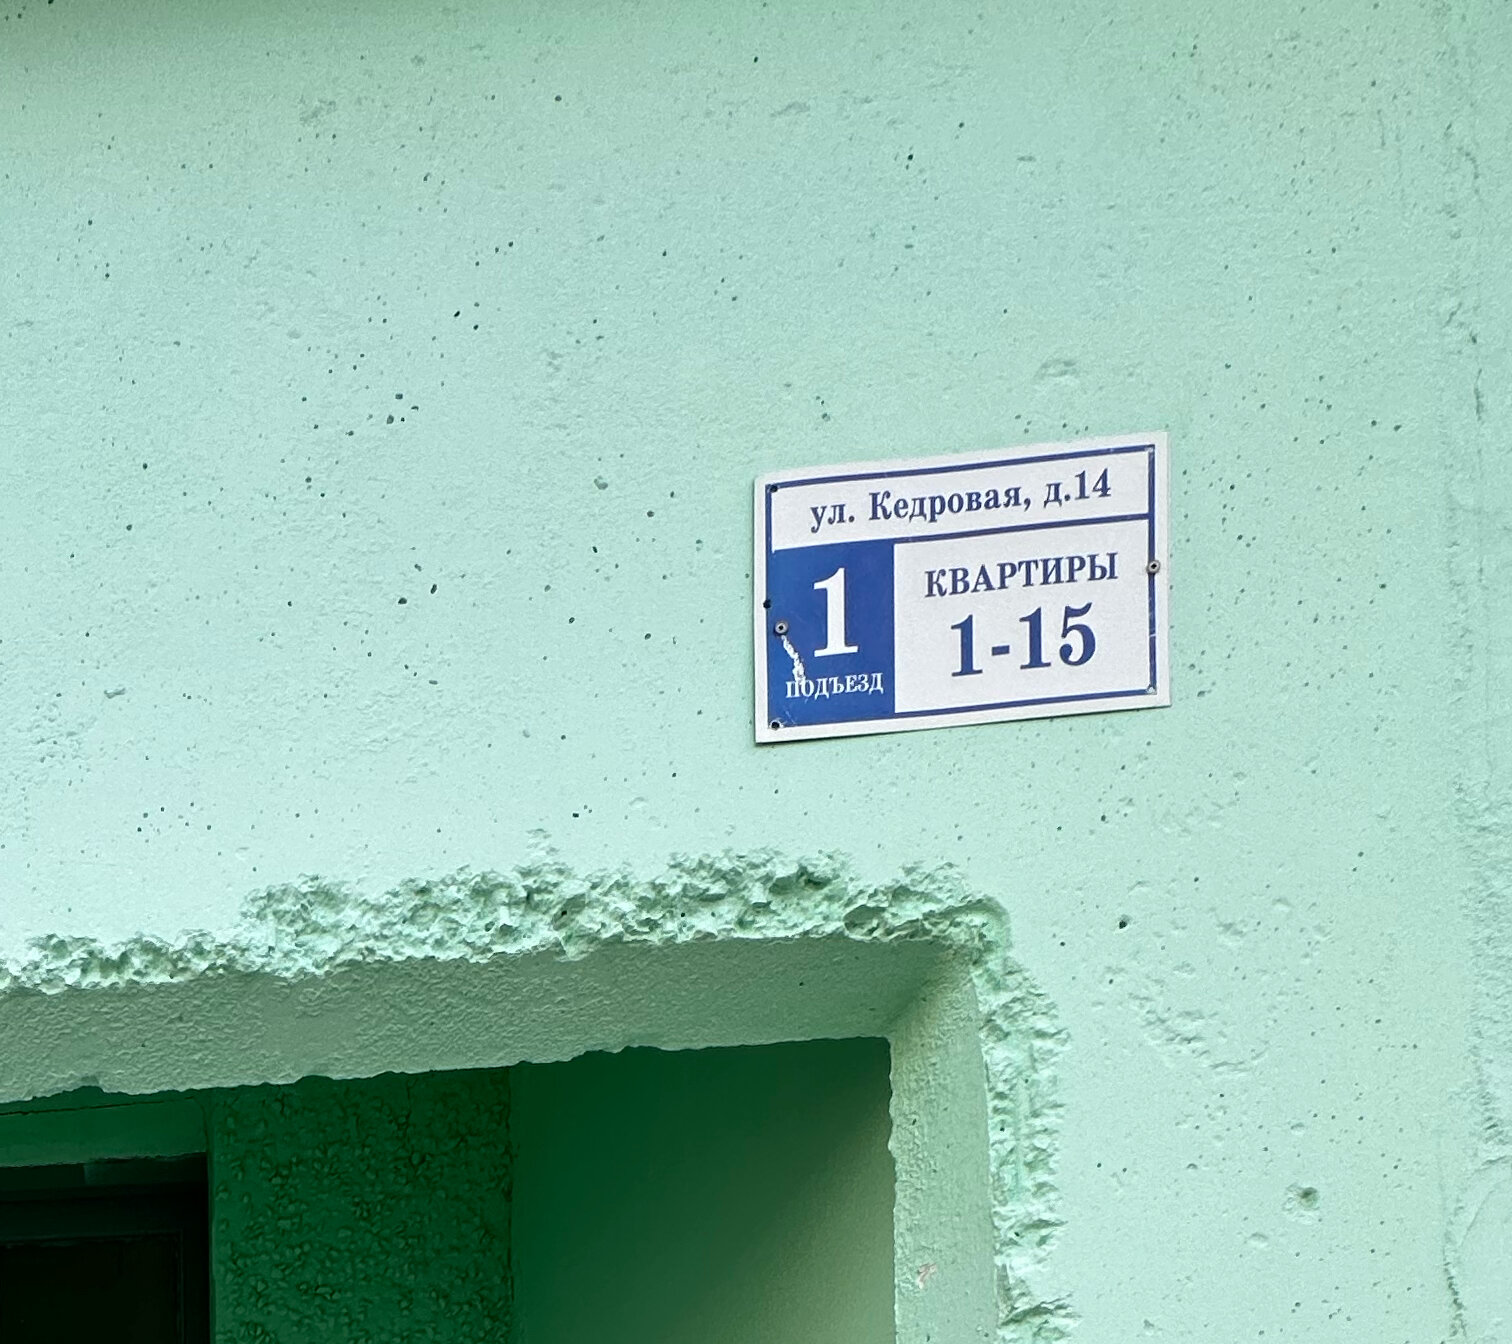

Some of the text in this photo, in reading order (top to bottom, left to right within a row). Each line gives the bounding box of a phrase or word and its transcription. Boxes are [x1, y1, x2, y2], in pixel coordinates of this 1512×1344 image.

[809, 467, 1112, 534] ул. Кедровая, д.14
[924, 552, 1119, 598] КВАРТИРЫ
[811, 566, 860, 658] 1
[949, 602, 1097, 678] 1-15
